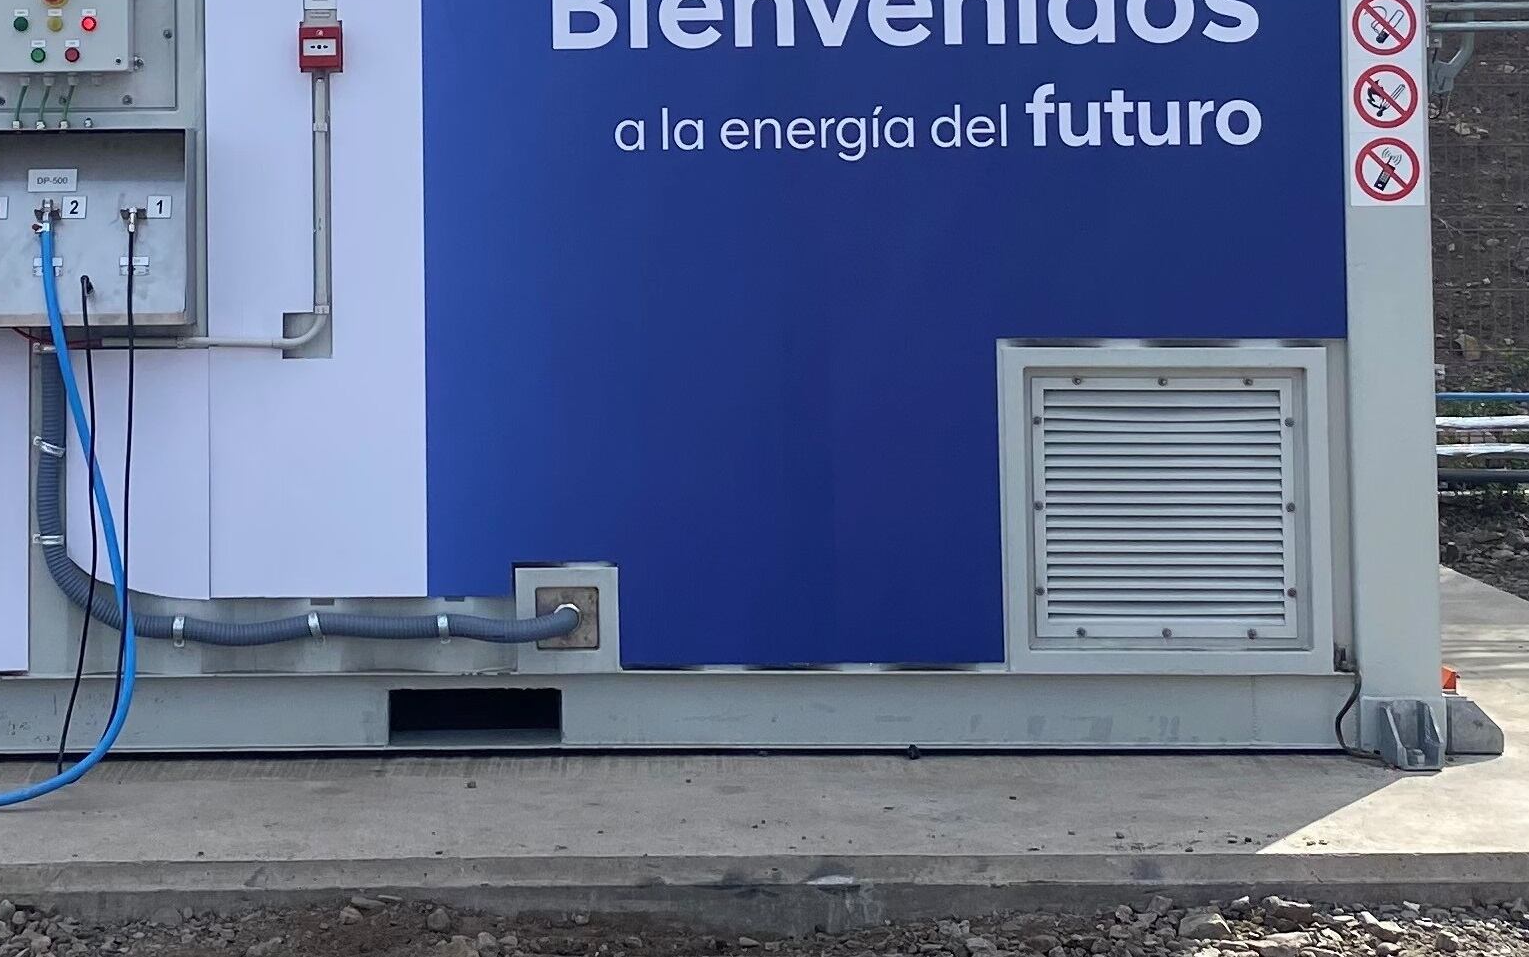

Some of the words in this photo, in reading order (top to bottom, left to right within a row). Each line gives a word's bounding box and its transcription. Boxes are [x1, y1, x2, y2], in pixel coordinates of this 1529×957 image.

[614, 116, 645, 150] a
[662, 108, 704, 150] la
[720, 107, 915, 161] energía
[931, 105, 1007, 147] del
[1025, 84, 1262, 146] futuro
[37, 176, 68, 185] DP-500
[70, 200, 79, 214] 2
[156, 200, 163, 214] 1
